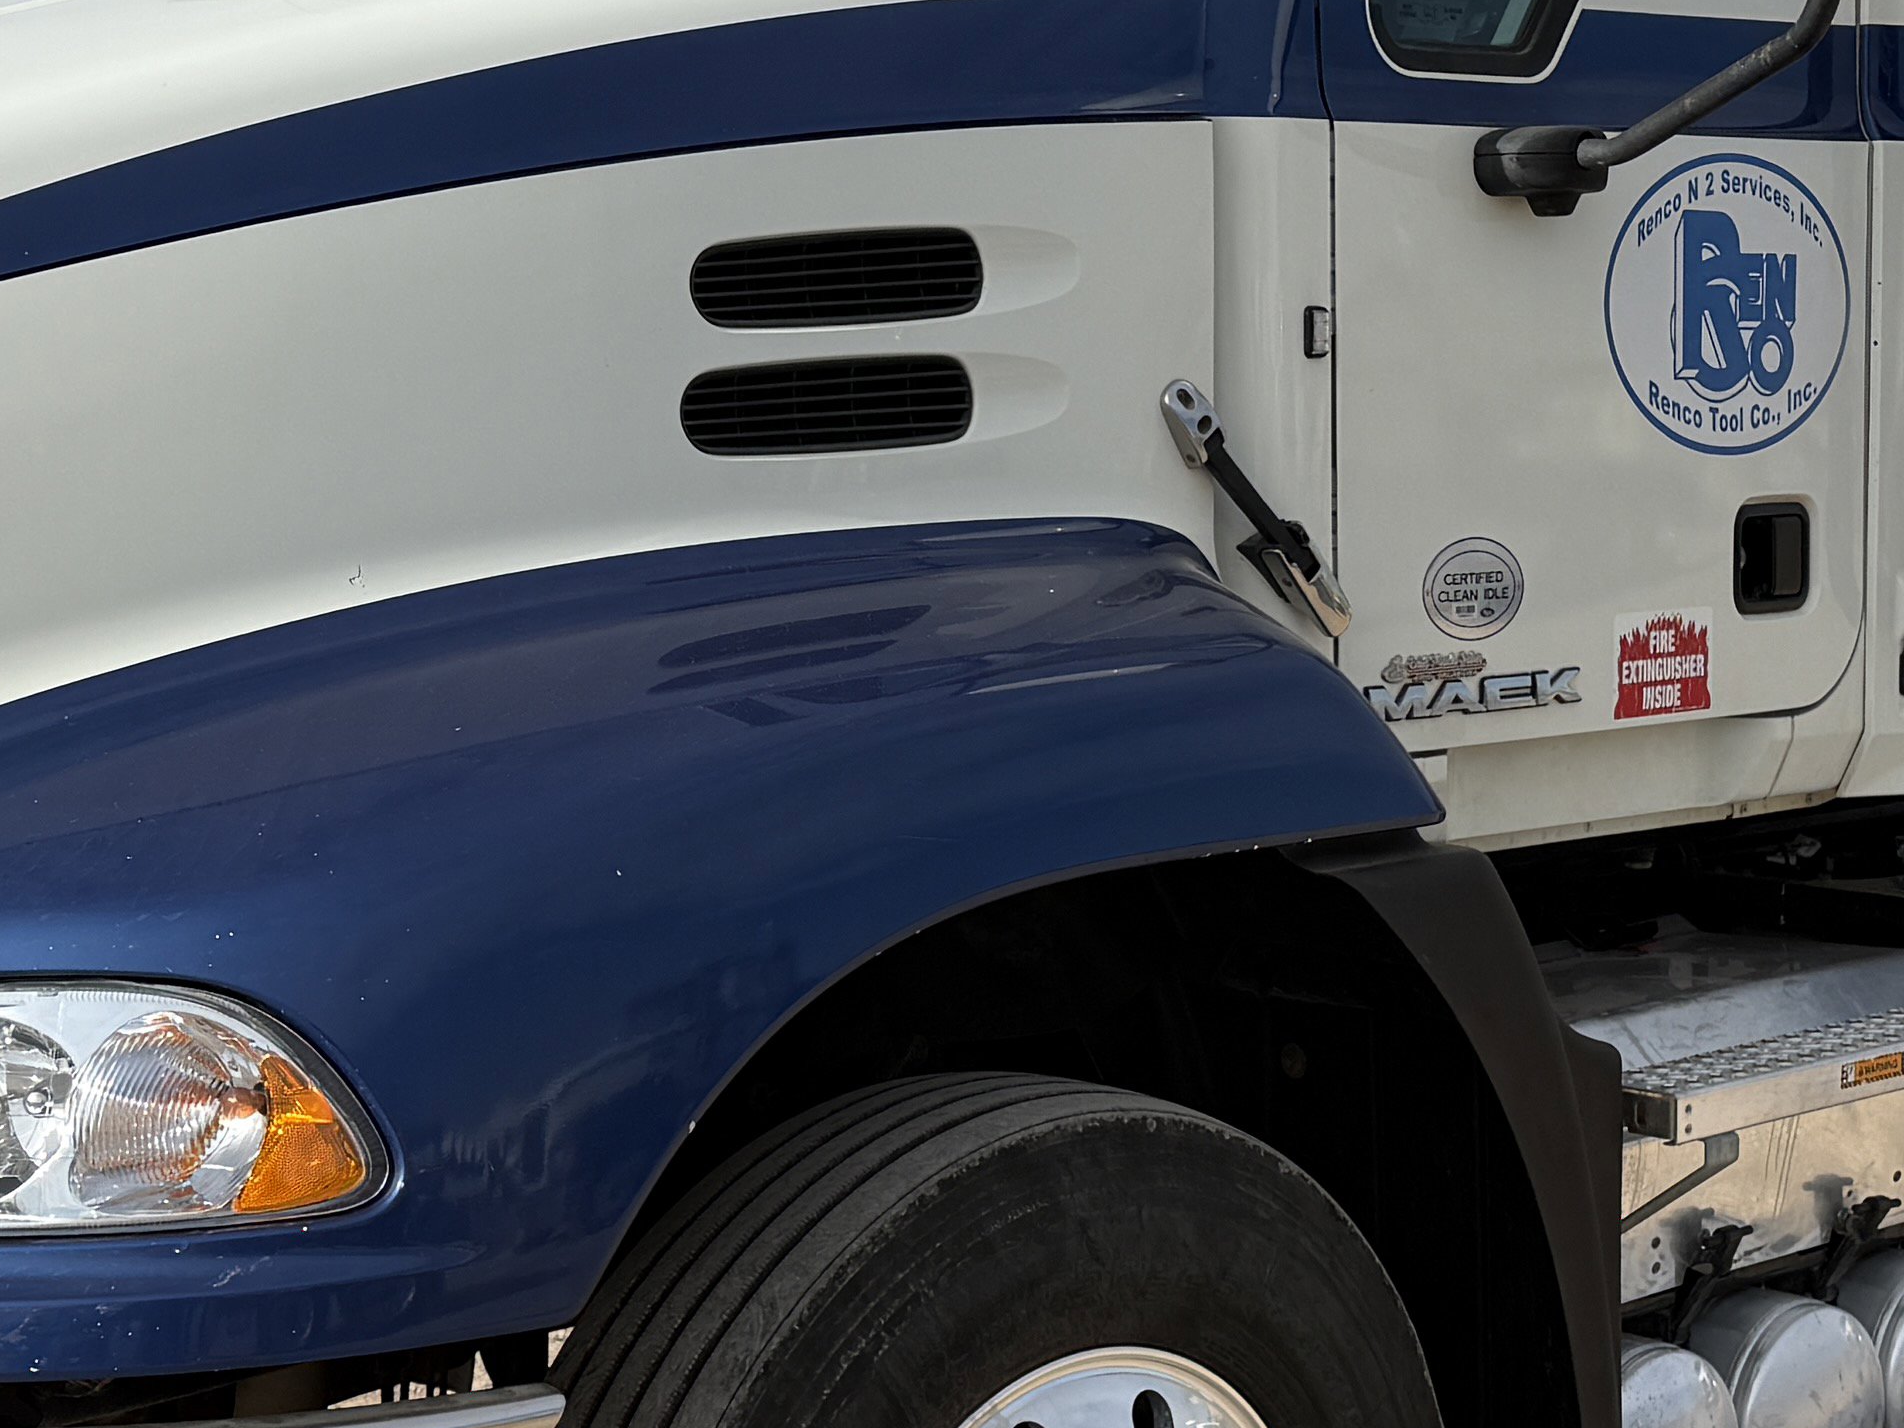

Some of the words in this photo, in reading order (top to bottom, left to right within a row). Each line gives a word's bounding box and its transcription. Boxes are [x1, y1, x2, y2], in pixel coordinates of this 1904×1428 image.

[1637, 192, 1682, 248] Renco
[1688, 176, 1699, 201] N
[1705, 171, 1715, 197] 2
[1720, 169, 1796, 223] Services,
[1800, 201, 1823, 249] Inc.
[1649, 379, 1703, 429] Renco
[1709, 406, 1744, 432] Tool
[1787, 380, 1818, 415] Inc.
[1443, 570, 1504, 586] CERTIFIED
[1438, 589, 1478, 603] CLEAN
[1483, 586, 1510, 600] IDLE
[1649, 629, 1676, 654] FIRE
[1622, 654, 1705, 685] EXTINGUISHER
[1363, 666, 1583, 722] MACK
[1642, 683, 1682, 710] INSIDE
